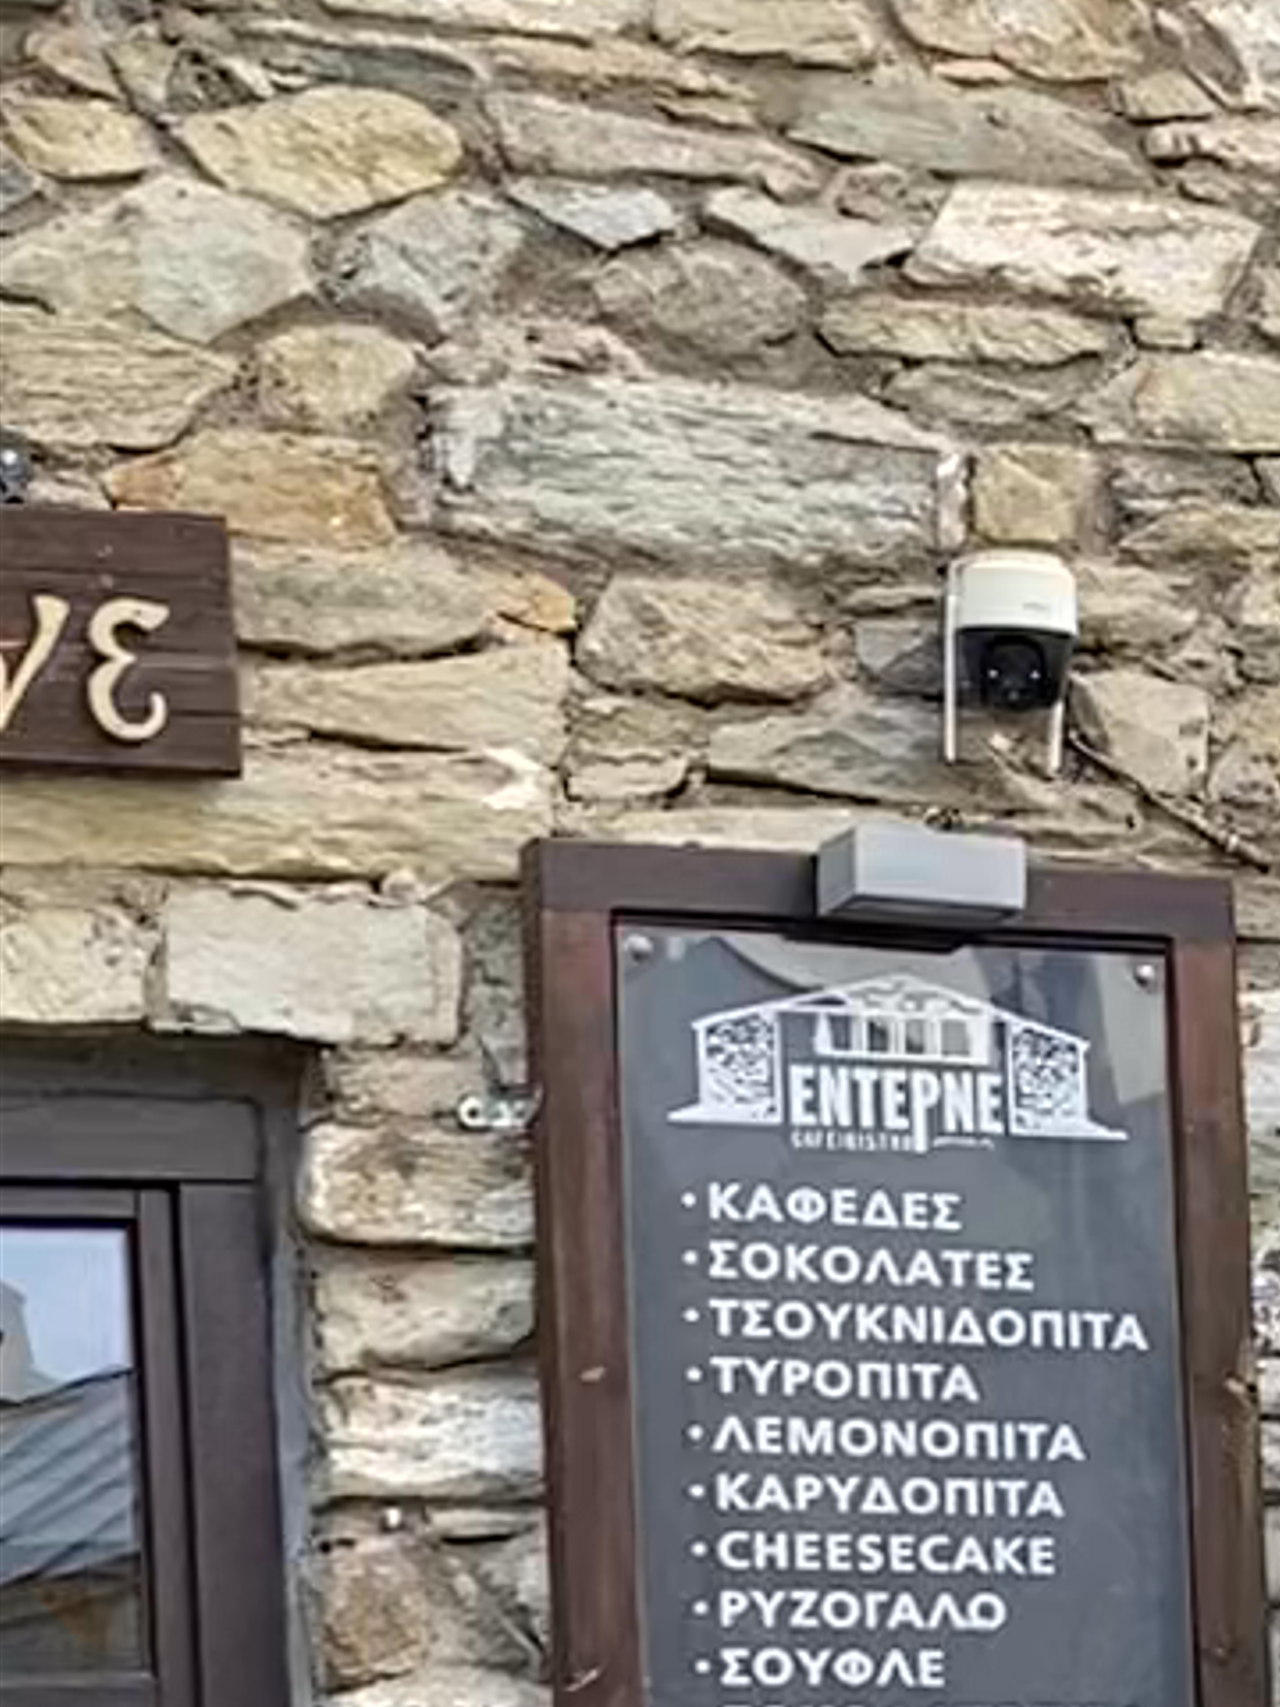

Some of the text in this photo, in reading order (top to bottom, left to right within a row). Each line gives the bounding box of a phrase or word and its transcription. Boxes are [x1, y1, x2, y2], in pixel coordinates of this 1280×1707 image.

[708, 1181, 963, 1231] ΚΑΦΕΔΕΣ
[708, 1240, 1035, 1291] ΣΟΚΟΛΑΤΕΣ
[708, 1298, 1149, 1351] ΤΣΟΥΚΝΙΔΟΠΙΤΑ
[709, 1356, 980, 1403] ΤΥΡΟΠΙΤΑ
[712, 1415, 1086, 1462] ΛΕΜΟΝΟΠΙΤΑ
[715, 1472, 1065, 1519] ΚΑΡΥΔΟΠΙΤΑ
[717, 1530, 1056, 1575] CHEESECAKE
[719, 1589, 1007, 1631] ΡΥΖΟΓΑΛΩ
[720, 1647, 946, 1687] ΣΟΥΦΛΕ
